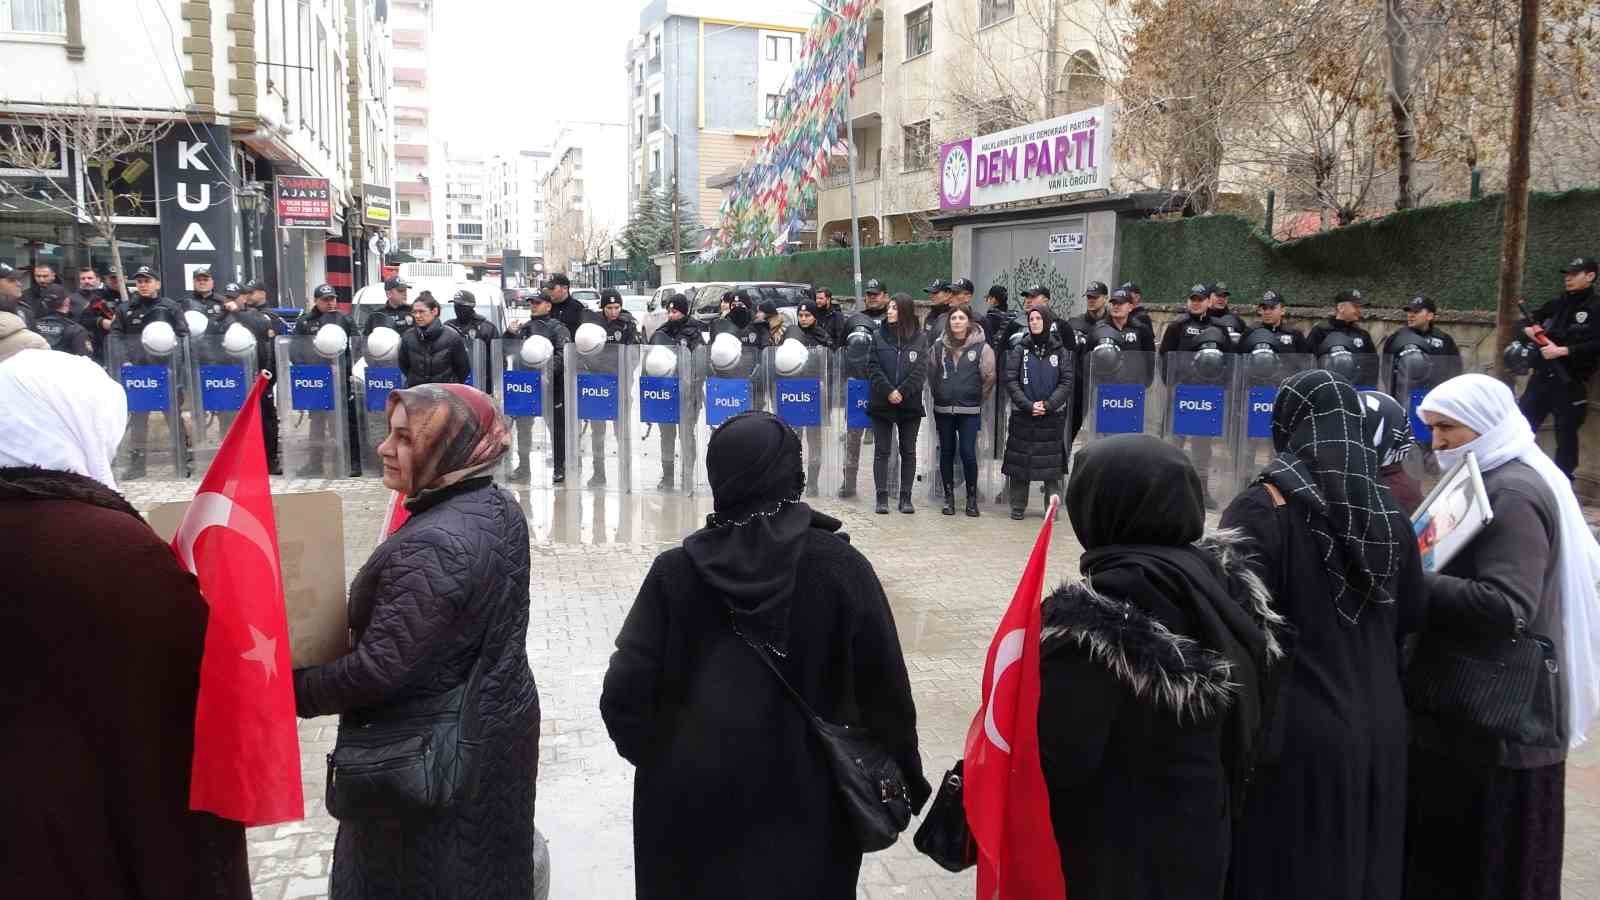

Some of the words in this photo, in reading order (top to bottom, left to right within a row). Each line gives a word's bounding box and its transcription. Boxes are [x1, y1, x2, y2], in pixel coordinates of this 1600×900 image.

[976, 146, 1018, 187] DEM
[1024, 116, 1097, 180] PARTİ
[1048, 178, 1061, 191] VAN
[281, 189, 327, 198] AJANS
[126, 377, 158, 388] POLİS
[205, 377, 236, 388] POLİS
[368, 378, 394, 389] POLİS
[506, 383, 533, 394] POLİS
[582, 386, 609, 398] POLİS
[643, 388, 671, 400] POLİS
[715, 397, 740, 408] POLİS
[781, 391, 811, 403] POLİS
[1102, 398, 1134, 409] POLİS
[1179, 399, 1213, 411] POLİS
